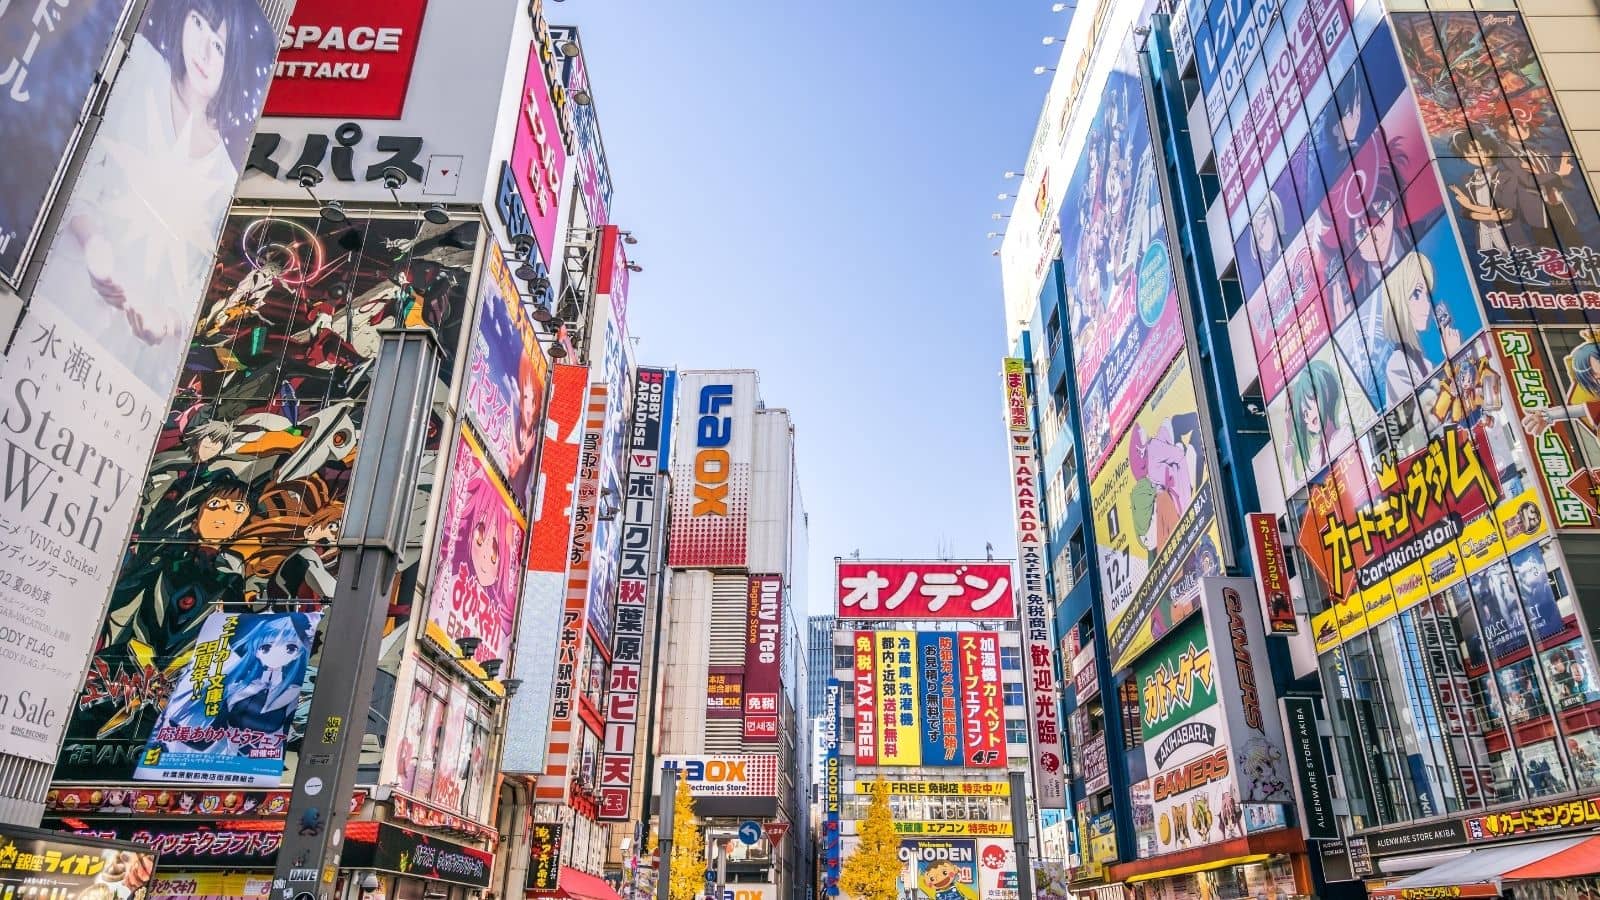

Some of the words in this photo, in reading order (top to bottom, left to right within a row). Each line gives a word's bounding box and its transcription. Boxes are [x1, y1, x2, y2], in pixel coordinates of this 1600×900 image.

[1324, 14, 1340, 48] 6F
[31, 324, 151, 431] 水瀬いのり
[648, 372, 663, 423] HOBBY
[633, 372, 651, 447] PARADISE
[1, 378, 134, 513] Starry
[4, 438, 103, 554] Wish
[1015, 455, 1038, 543] TAKARADA
[1323, 428, 1498, 597] カードキングダム
[842, 565, 1009, 612] オノデン
[1106, 544, 1131, 596] 12.7
[750, 580, 760, 616] Flagship
[758, 581, 780, 621] Duty
[1120, 581, 1134, 604] SALE
[749, 618, 760, 643] Store
[1027, 594, 1048, 641] 免税商店
[25, 637, 56, 658] FLAG
[599, 475, 654, 817] ボークス秋葉原ホビー天国
[759, 624, 779, 664] Free
[856, 636, 872, 671] 免税
[1222, 587, 1266, 735] GAMERS
[205, 616, 240, 716] スニーカー文庫は
[553, 611, 580, 719] アキバ駅前店
[13, 690, 56, 728] Sale
[748, 697, 775, 710] 免税
[857, 673, 872, 707] TAX
[1030, 644, 1058, 746] 歓迎光臨
[157, 726, 288, 747] 応援ありがとうフェア
[746, 720, 775, 733] 면세점
[826, 685, 839, 749] Panasonic
[858, 711, 874, 758] FREE
[1296, 707, 1307, 736] AKIBA
[971, 750, 999, 764] 4F
[1159, 724, 1210, 763] AKIHABARA
[1302, 737, 1313, 769] STORE
[726, 784, 747, 792] Store
[827, 758, 839, 812] ONODEN
[892, 782, 925, 793] FREE
[928, 782, 960, 794] 免税店
[1154, 748, 1231, 803] GAMERS
[1308, 769, 1326, 829] ALIENWARE
[927, 823, 965, 834] エアコン
[1411, 831, 1433, 842] STORE
[1434, 827, 1456, 839] AKIBA
[16, 850, 104, 875] 銀座ライオン
[291, 869, 318, 881] DAVE
